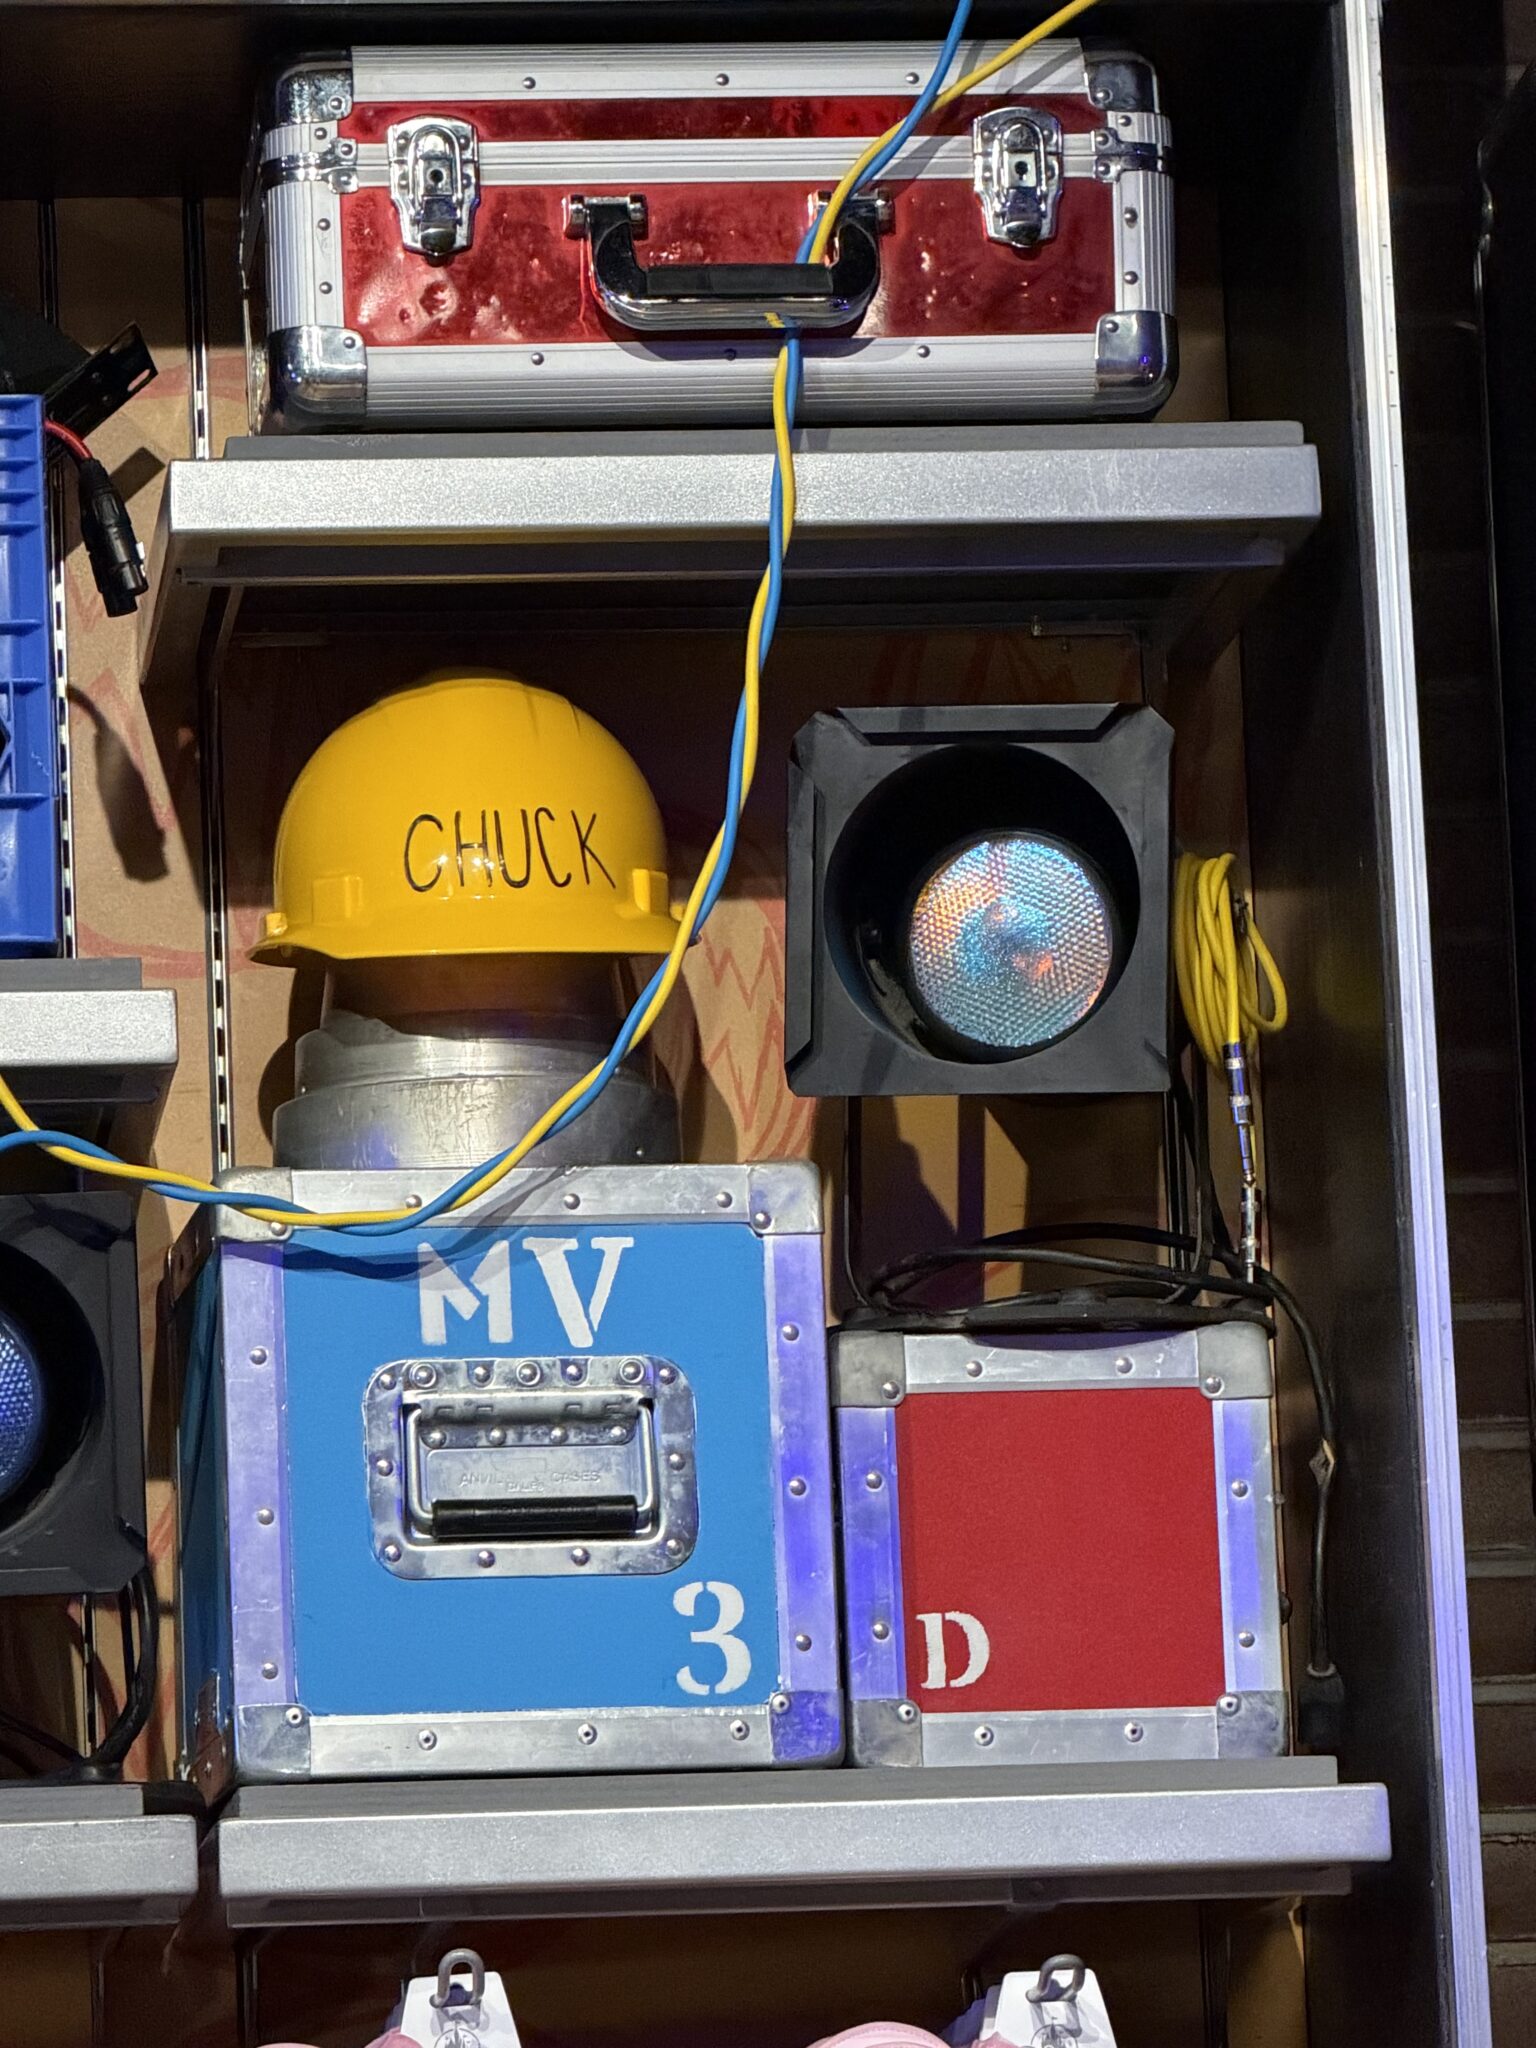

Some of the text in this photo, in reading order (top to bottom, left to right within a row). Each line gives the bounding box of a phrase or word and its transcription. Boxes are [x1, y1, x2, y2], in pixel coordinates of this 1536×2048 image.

[404, 807, 616, 892] CHUCK
[417, 1236, 635, 1349] MV
[672, 1581, 752, 1696] 3
[916, 1610, 990, 1690] D
